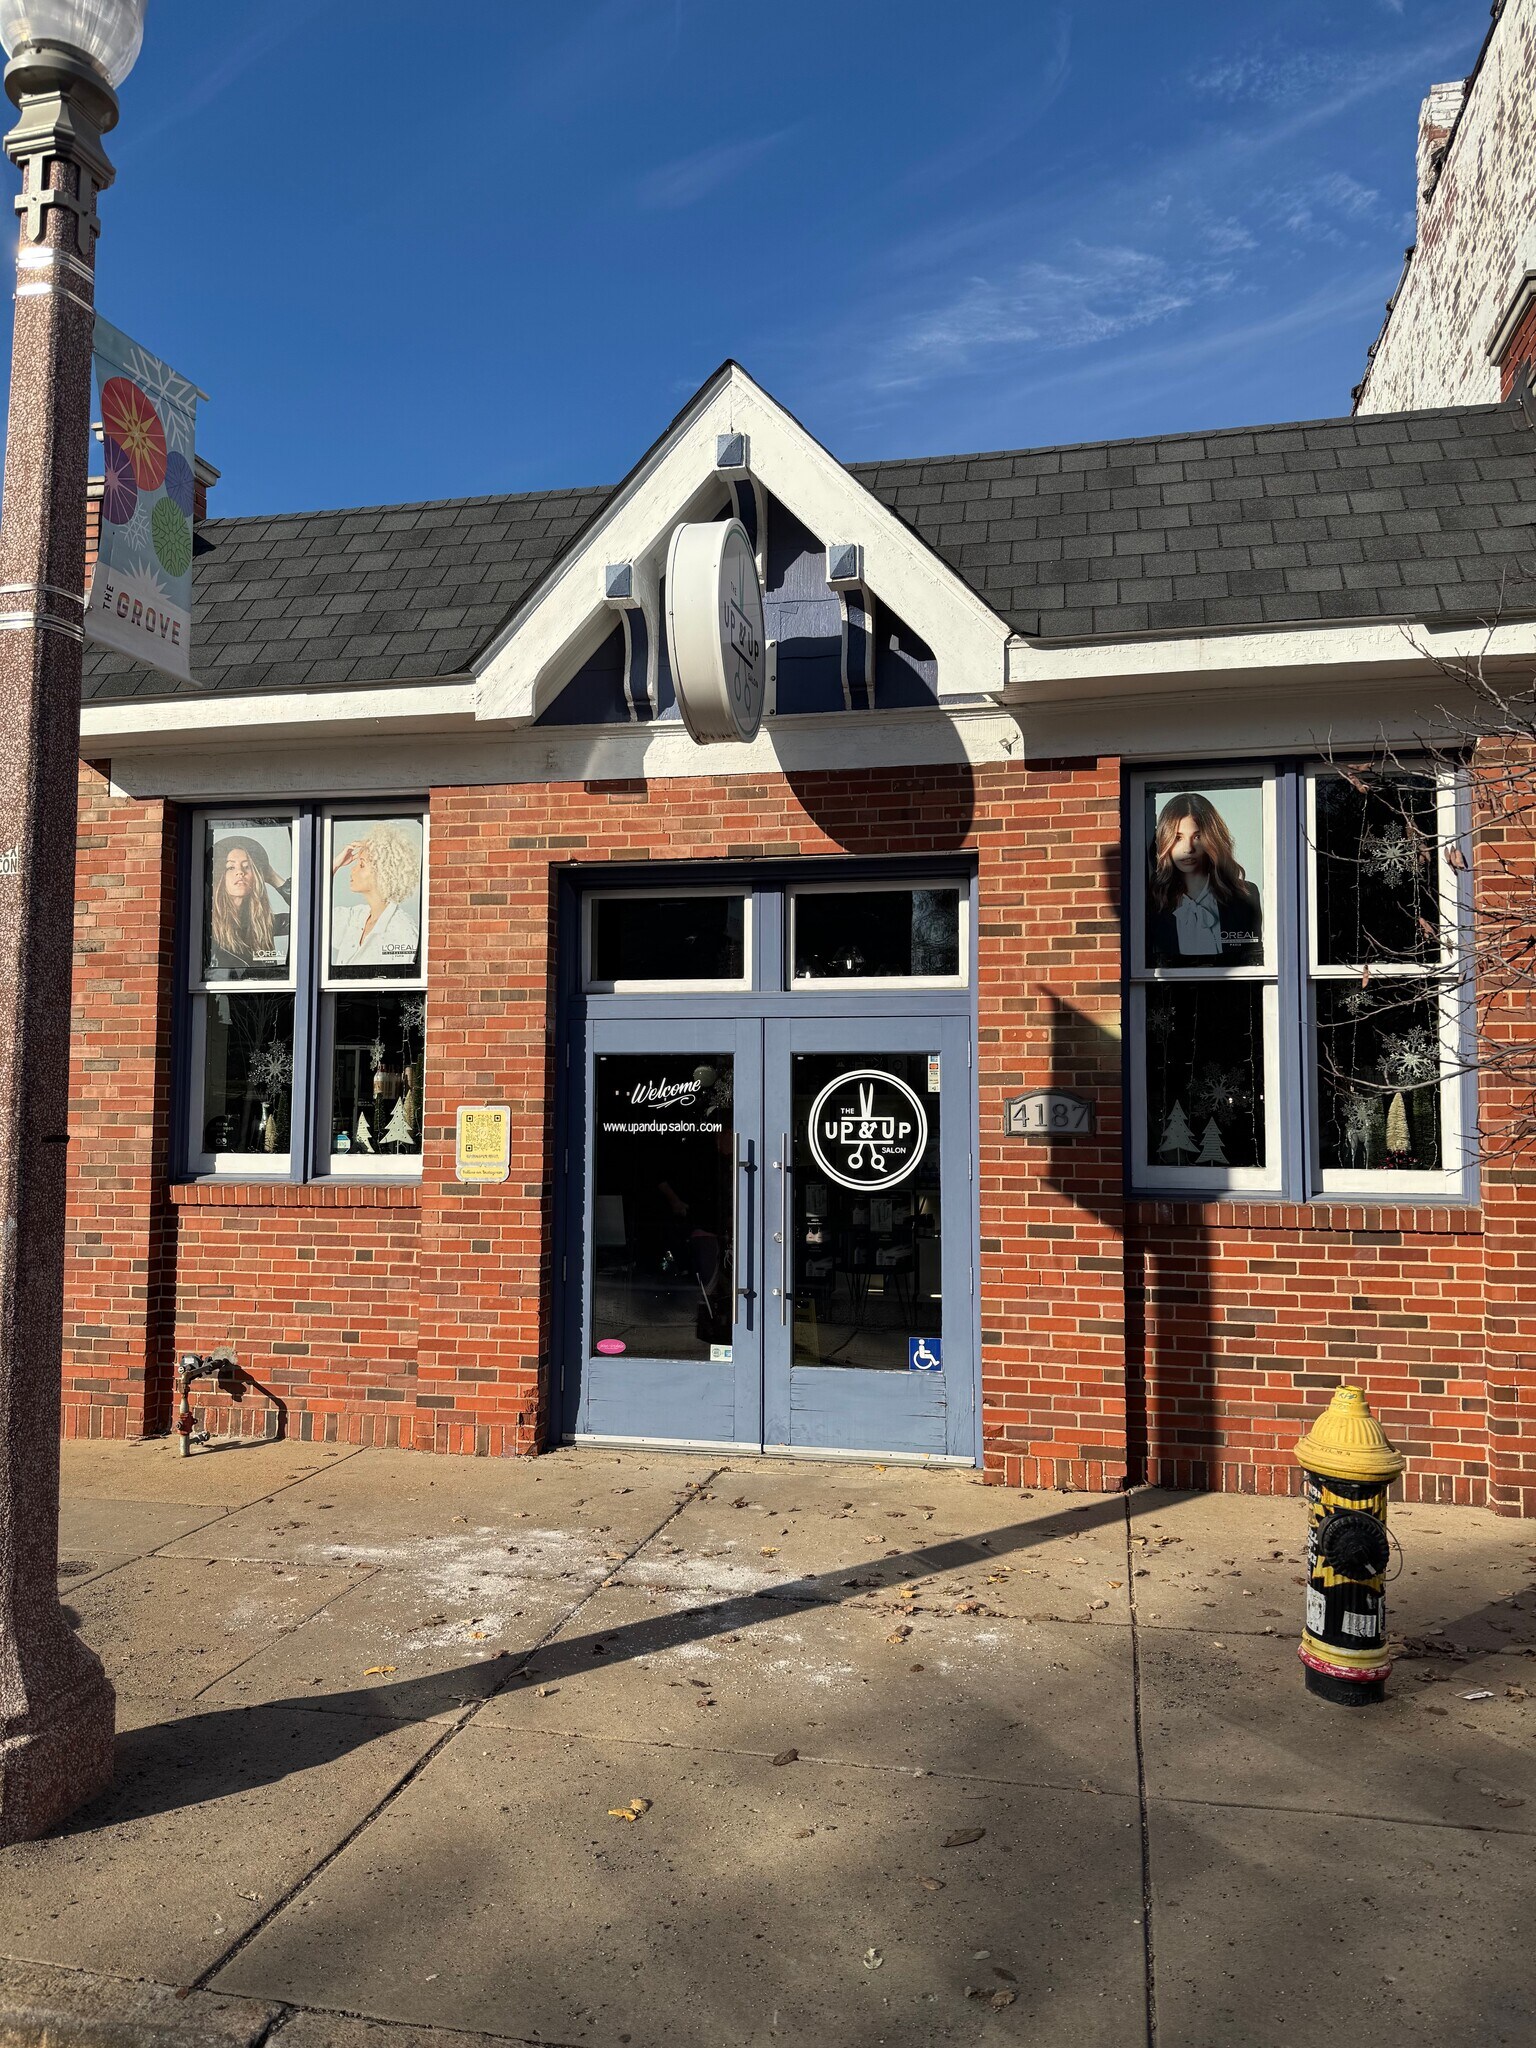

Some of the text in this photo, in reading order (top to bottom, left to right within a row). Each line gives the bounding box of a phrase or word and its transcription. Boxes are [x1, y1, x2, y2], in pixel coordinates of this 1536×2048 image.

[102, 583, 115, 610] THE
[730, 581, 738, 596] THE
[116, 592, 181, 646] GROVE
[724, 601, 760, 661] UP & UP
[1220, 931, 1259, 940] ORÉAL
[631, 1077, 702, 1106] Welcome
[840, 1107, 855, 1115] THE
[1012, 1104, 1089, 1128] 4187
[603, 1120, 722, 1135] www.upandupsalon.com
[825, 1121, 912, 1140] UP & UP
[881, 1146, 907, 1154] SALON
